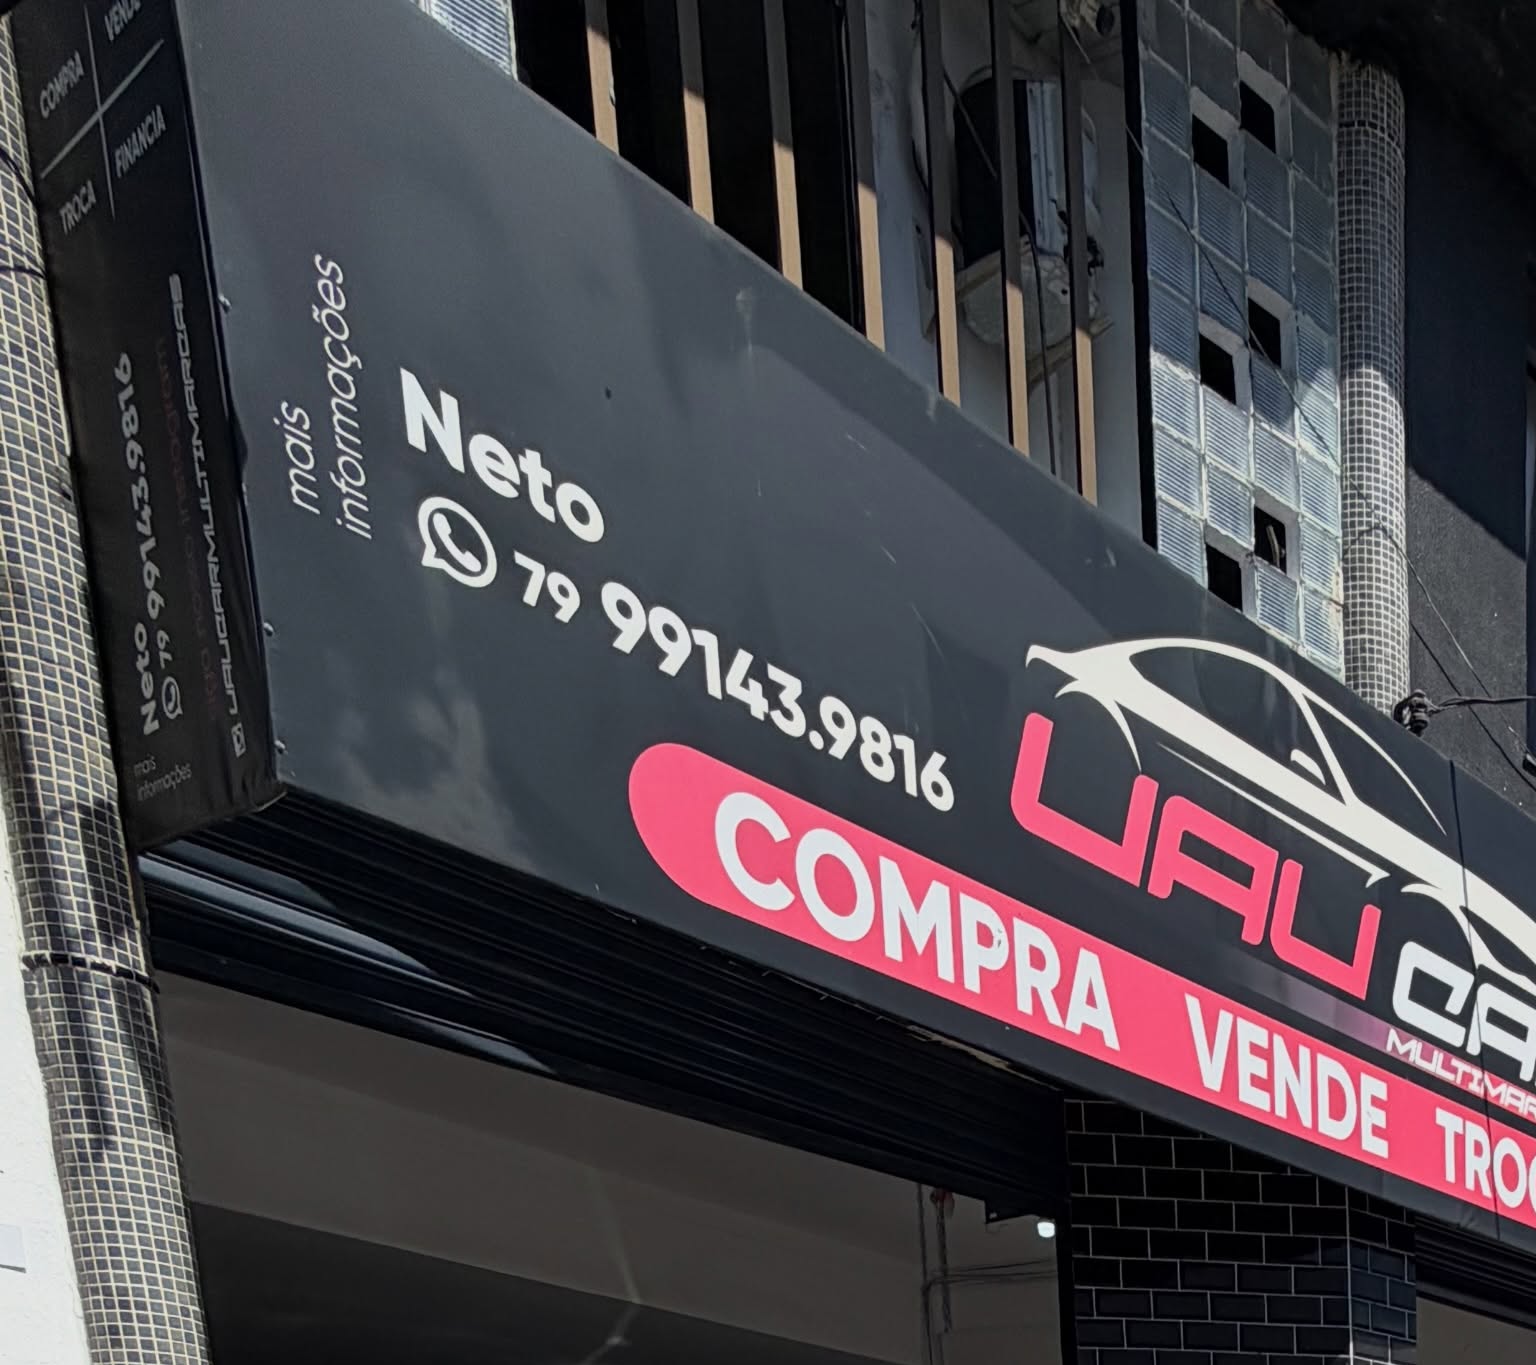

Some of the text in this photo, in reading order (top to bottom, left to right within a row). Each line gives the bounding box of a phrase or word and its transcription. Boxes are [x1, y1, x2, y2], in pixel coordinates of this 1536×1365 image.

[39, 51, 84, 118] COMPRA
[115, 104, 166, 178] FINANCIA
[59, 180, 96, 236] TROCA
[273, 401, 320, 514] mais
[312, 253, 372, 540] informações
[399, 366, 605, 543] Neto
[114, 352, 173, 669] 79 99143.9816
[134, 622, 160, 736] Neto
[513, 550, 955, 812] 79 99143.9816
[714, 792, 1120, 1052] COMPRA
[1184, 994, 1389, 1160] VENDE
